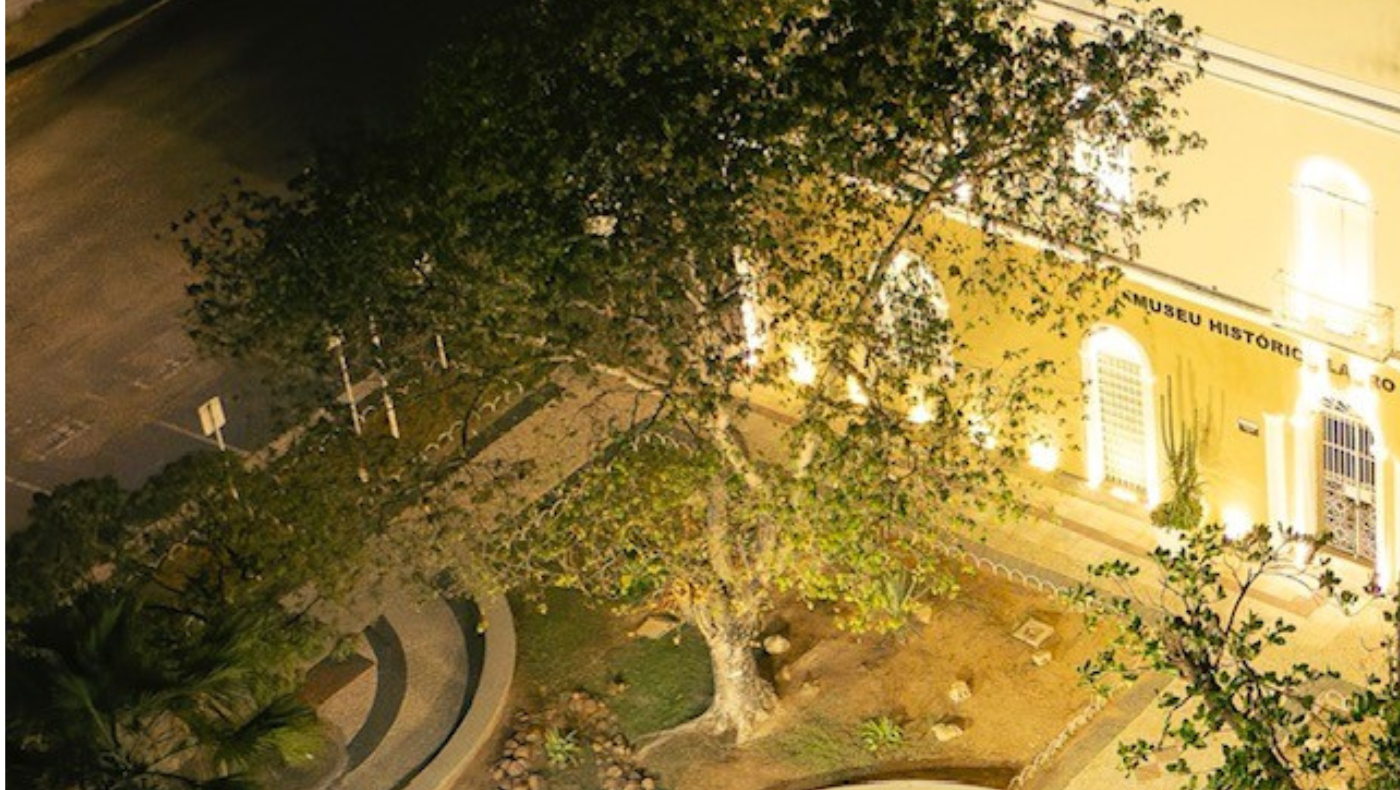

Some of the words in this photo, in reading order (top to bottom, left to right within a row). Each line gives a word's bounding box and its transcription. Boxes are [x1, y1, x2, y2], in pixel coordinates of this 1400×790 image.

[1132, 293, 1202, 327] MUSEU
[1208, 318, 1319, 373] HISTÓRIC
[1326, 357, 1396, 393] LARO
